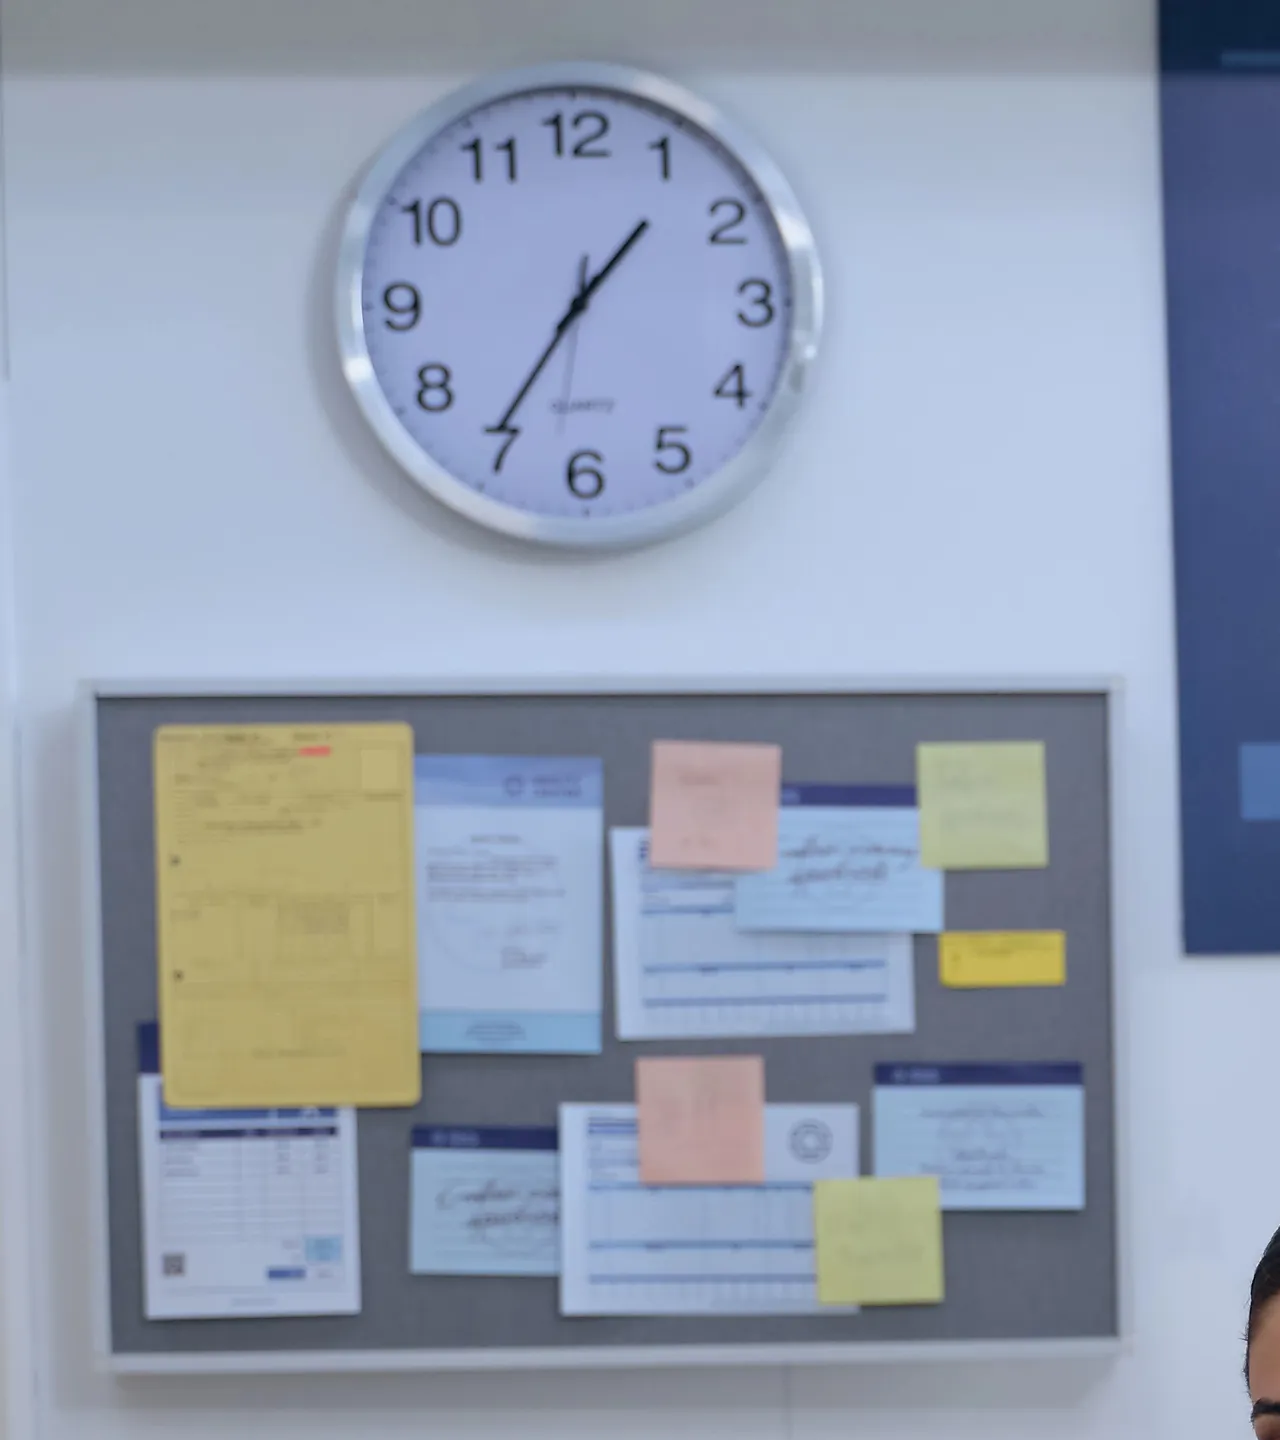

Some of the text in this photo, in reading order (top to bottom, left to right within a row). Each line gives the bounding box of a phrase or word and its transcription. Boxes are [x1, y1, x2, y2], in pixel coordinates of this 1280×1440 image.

[542, 110, 612, 158] 12
[648, 135, 672, 182] 1
[460, 136, 518, 183] 11
[401, 196, 463, 247] 10
[707, 199, 750, 245] 2
[381, 282, 422, 332] 9
[736, 278, 777, 328] 3
[415, 363, 455, 414] 8
[712, 363, 751, 409] 4
[483, 424, 521, 474] 7
[653, 425, 692, 475] 5
[565, 450, 606, 499] 6
